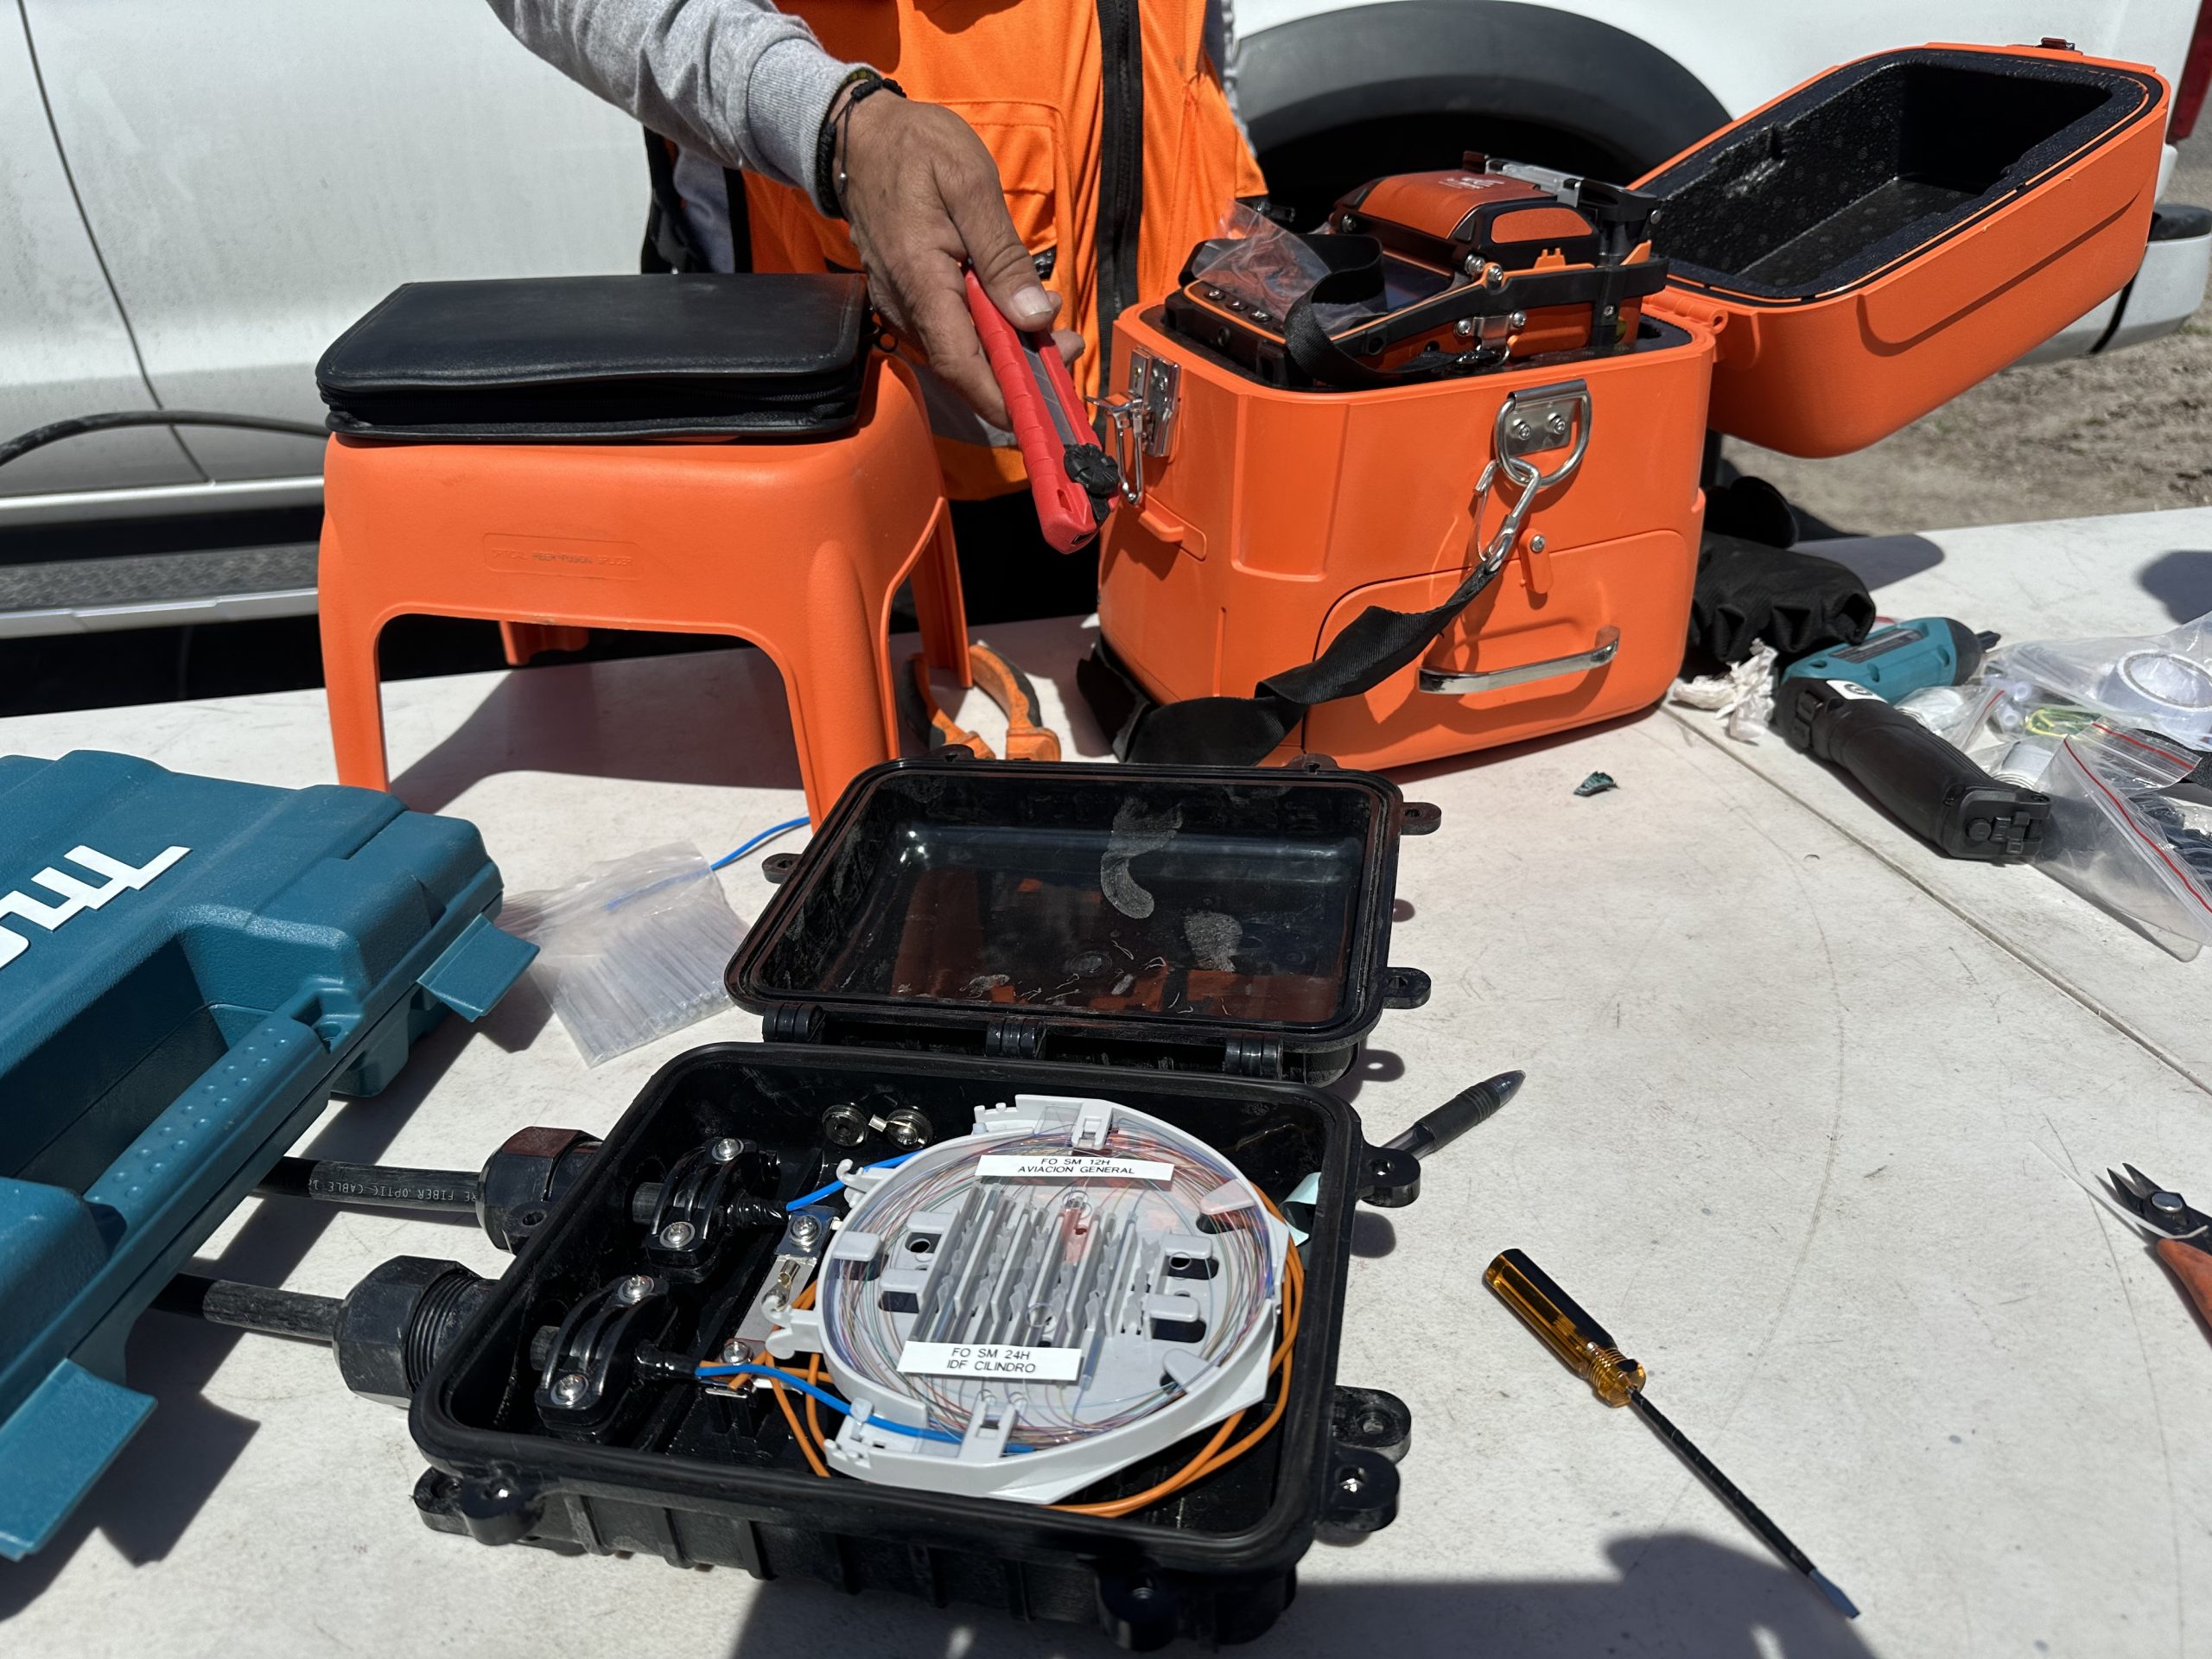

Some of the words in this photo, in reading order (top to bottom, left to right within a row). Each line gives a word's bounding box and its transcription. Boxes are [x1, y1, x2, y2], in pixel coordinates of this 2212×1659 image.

[1017, 1166, 1074, 1174] AVIACION
[1079, 1166, 1135, 1175] GENERAL
[329, 1181, 364, 1194] CABLE
[372, 1185, 409, 1198] OPTIC
[417, 1189, 454, 1201] FIBER
[951, 1347, 971, 1357] FO
[977, 1348, 998, 1358] SM
[1004, 1350, 1031, 1360] 24H
[946, 1359, 968, 1370] IDF
[974, 1360, 1036, 1373] CILINDRO
